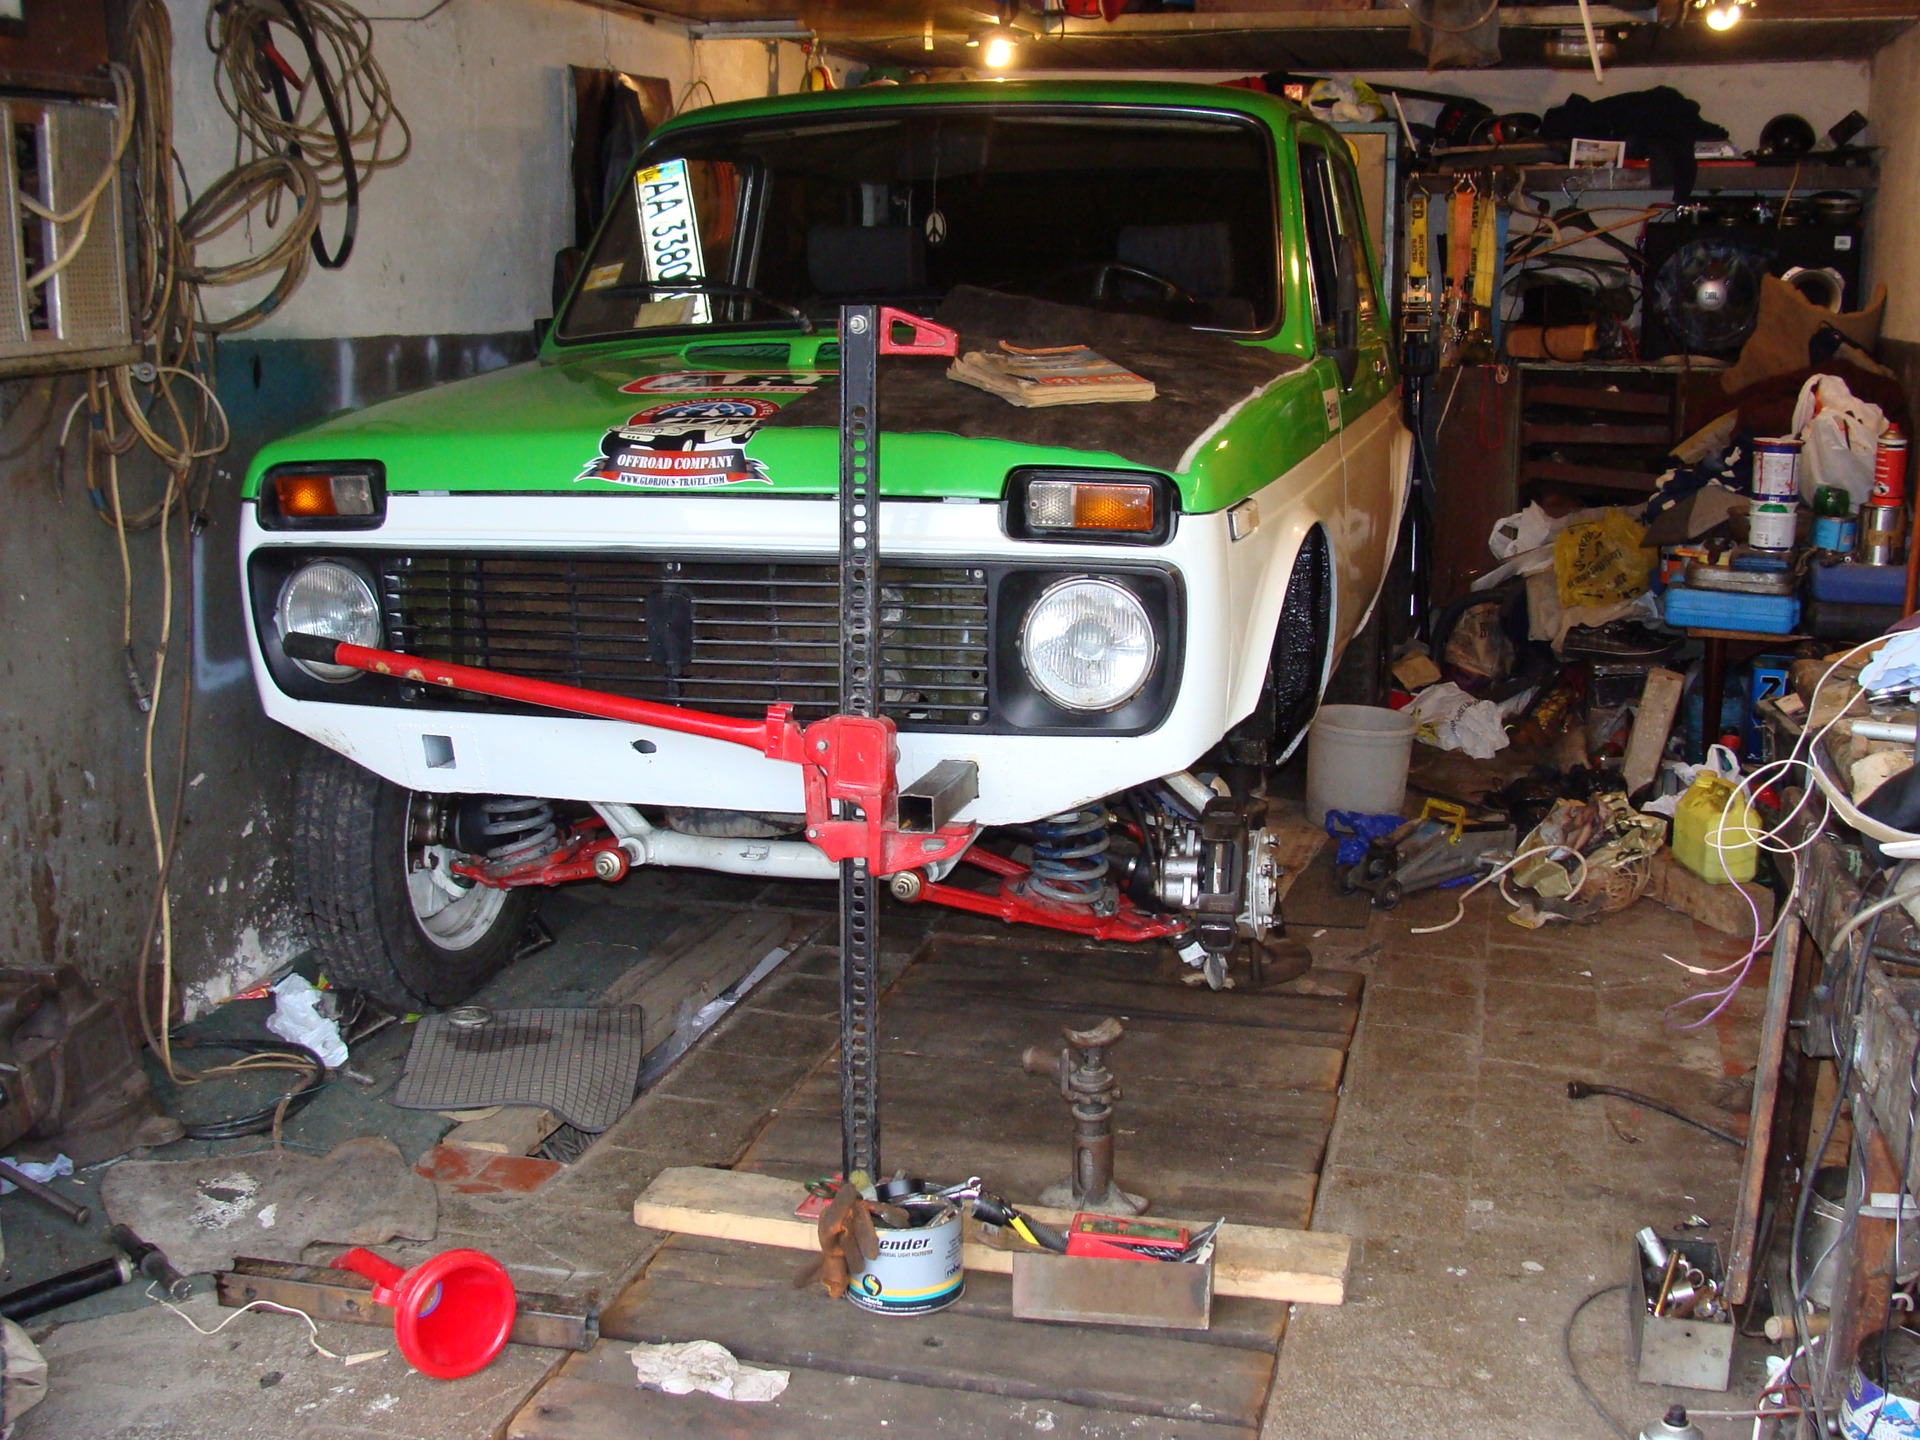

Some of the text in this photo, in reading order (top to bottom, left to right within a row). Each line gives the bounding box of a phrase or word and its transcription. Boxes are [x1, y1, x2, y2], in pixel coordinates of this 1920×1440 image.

[641, 398, 774, 417] GLORIOUS TRAVEL
[616, 453, 734, 470] OFFROAD COMPANY
[620, 474, 725, 487] WWW.GLORIOUS-TRAVEL.COM
[879, 1237, 931, 1250] ender
